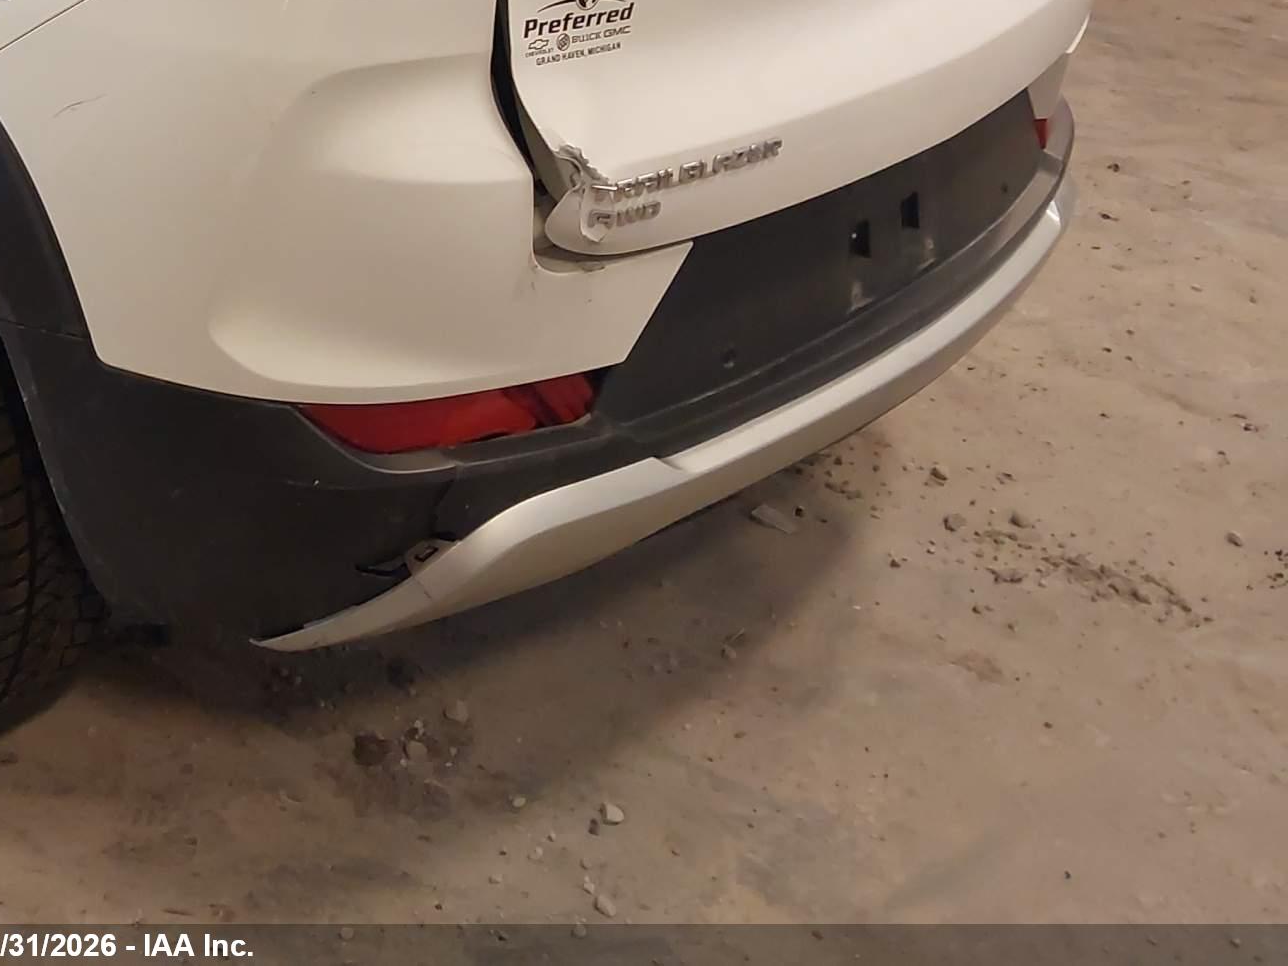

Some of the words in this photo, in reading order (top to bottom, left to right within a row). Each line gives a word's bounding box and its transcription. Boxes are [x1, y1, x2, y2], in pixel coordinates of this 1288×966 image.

[523, 1, 635, 39] Preferred
[571, 30, 602, 44] BUICK
[603, 25, 632, 38] GMC
[535, 54, 561, 66] GRAND
[587, 42, 622, 55] MICHIGAN
